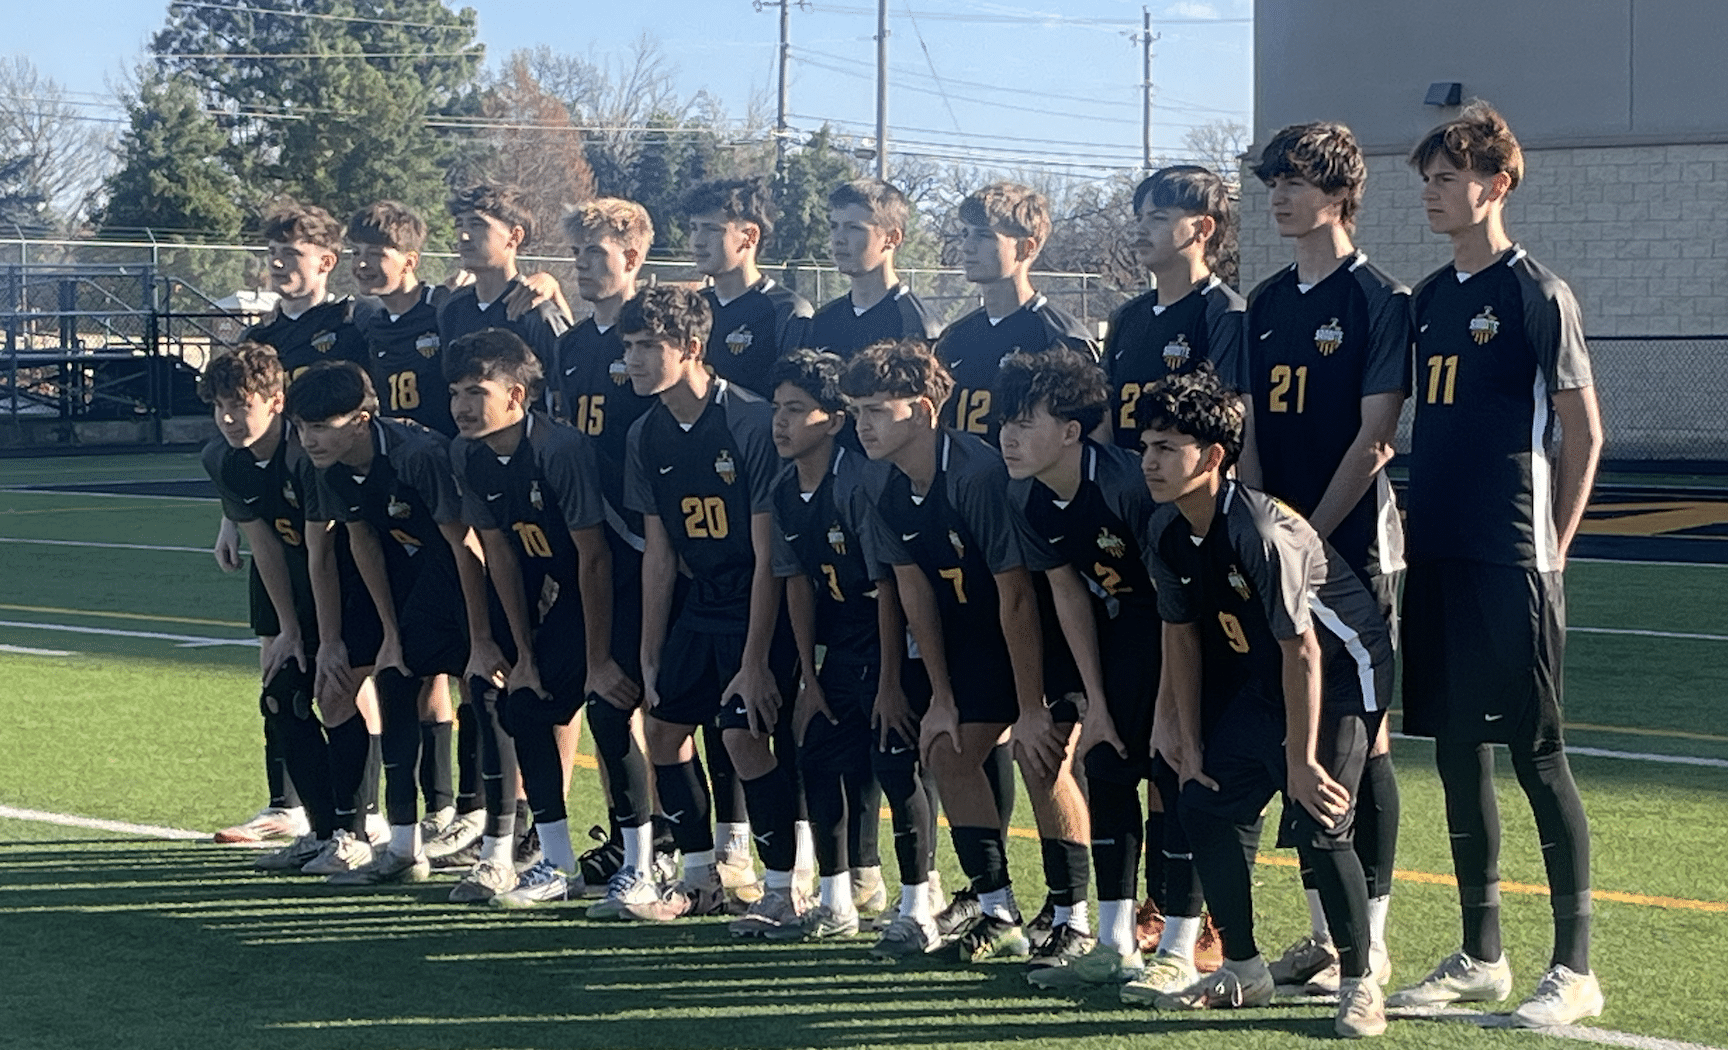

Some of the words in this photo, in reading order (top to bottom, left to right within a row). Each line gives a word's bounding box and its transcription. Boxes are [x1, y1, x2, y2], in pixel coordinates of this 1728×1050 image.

[387, 370, 420, 411] 18
[1268, 364, 1308, 414] 21
[1426, 354, 1460, 405] 11
[577, 394, 606, 436] 15
[956, 387, 992, 435] 12
[511, 521, 554, 557] 10
[680, 495, 729, 539] 20
[937, 567, 968, 604] 7
[1217, 610, 1250, 654] 9
